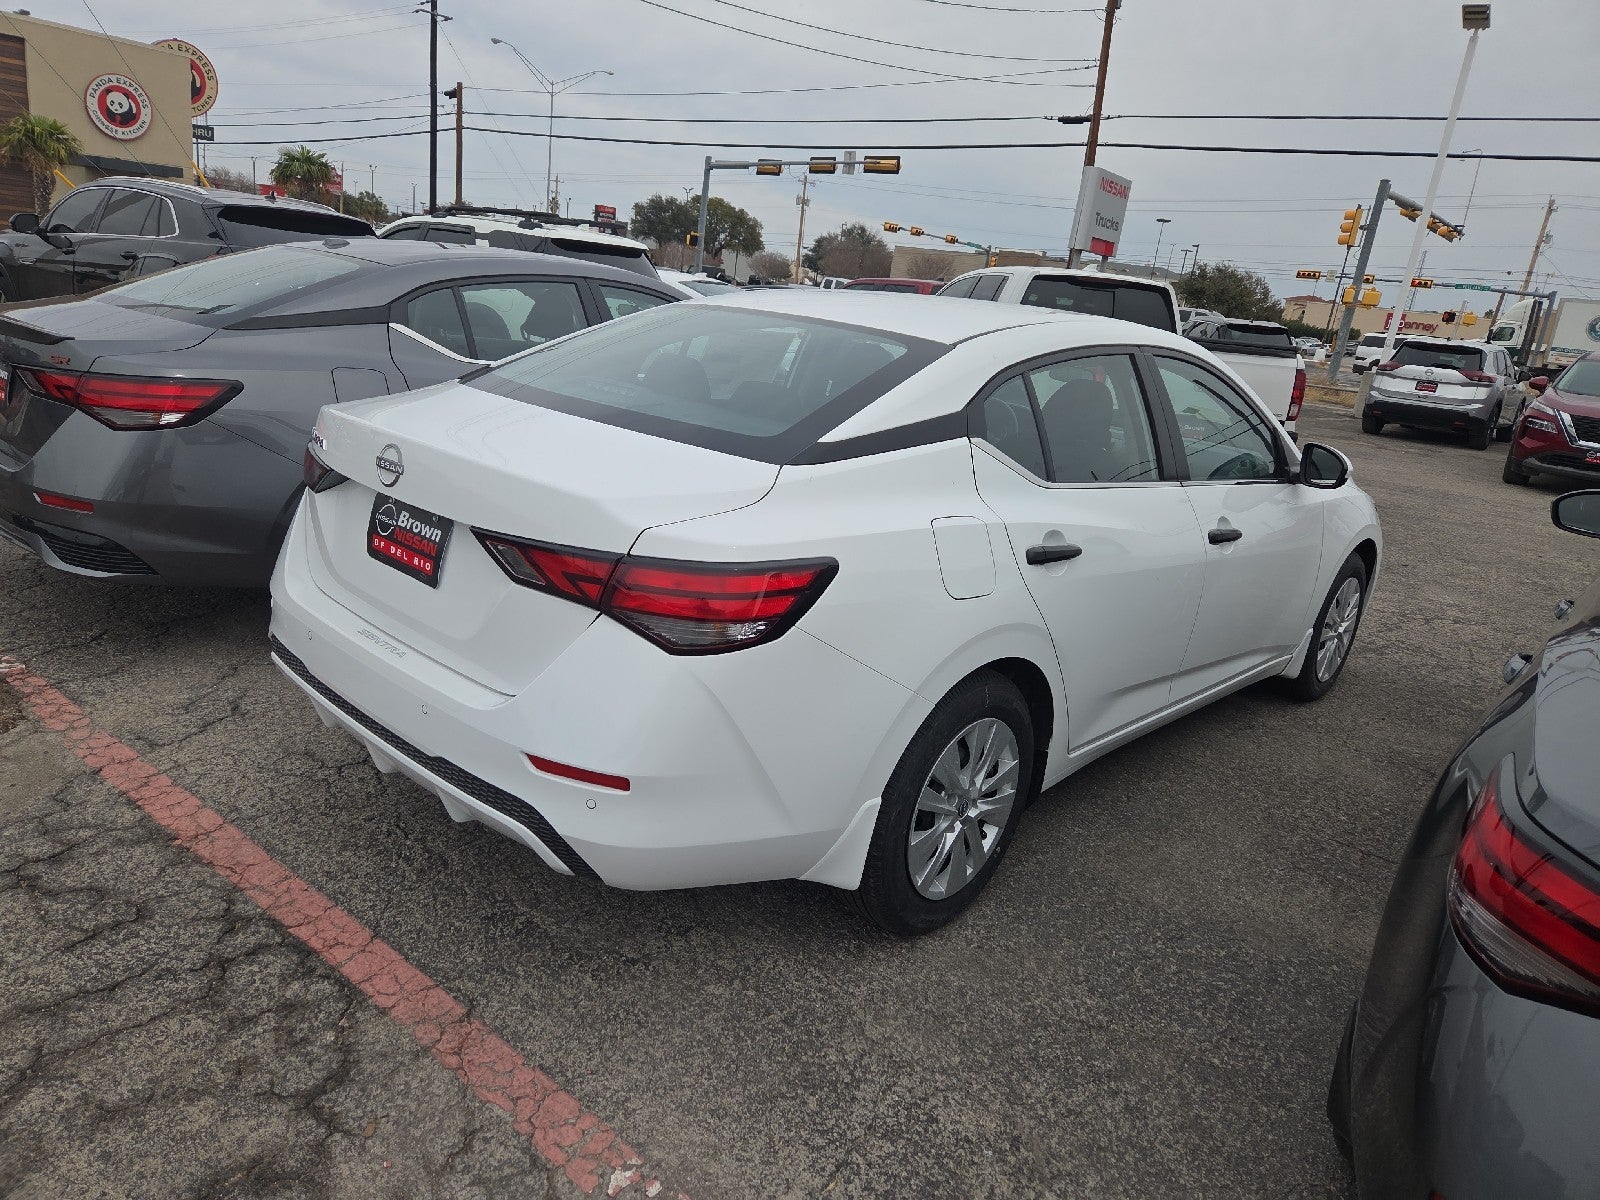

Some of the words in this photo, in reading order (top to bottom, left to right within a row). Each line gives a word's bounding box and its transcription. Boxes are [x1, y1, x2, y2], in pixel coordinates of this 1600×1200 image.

[177, 43, 214, 81] EXPRESS
[88, 76, 114, 99] PANDA
[116, 76, 149, 110] EXPRESS
[191, 94, 213, 114] TCHEN
[92, 109, 119, 135] CHINESE
[121, 119, 148, 136] KITCHEN
[192, 127, 213, 138] HRU
[1099, 176, 1129, 200] NISSAN
[1095, 211, 1120, 231] Trucks
[1385, 316, 1438, 334] jpenney
[397, 510, 442, 543] Brown
[374, 538, 385, 549] OF
[390, 545, 408, 561] DEL
[413, 556, 431, 571] RIO
[394, 527, 438, 557] NISSAN
[356, 629, 407, 658] SENTRA
